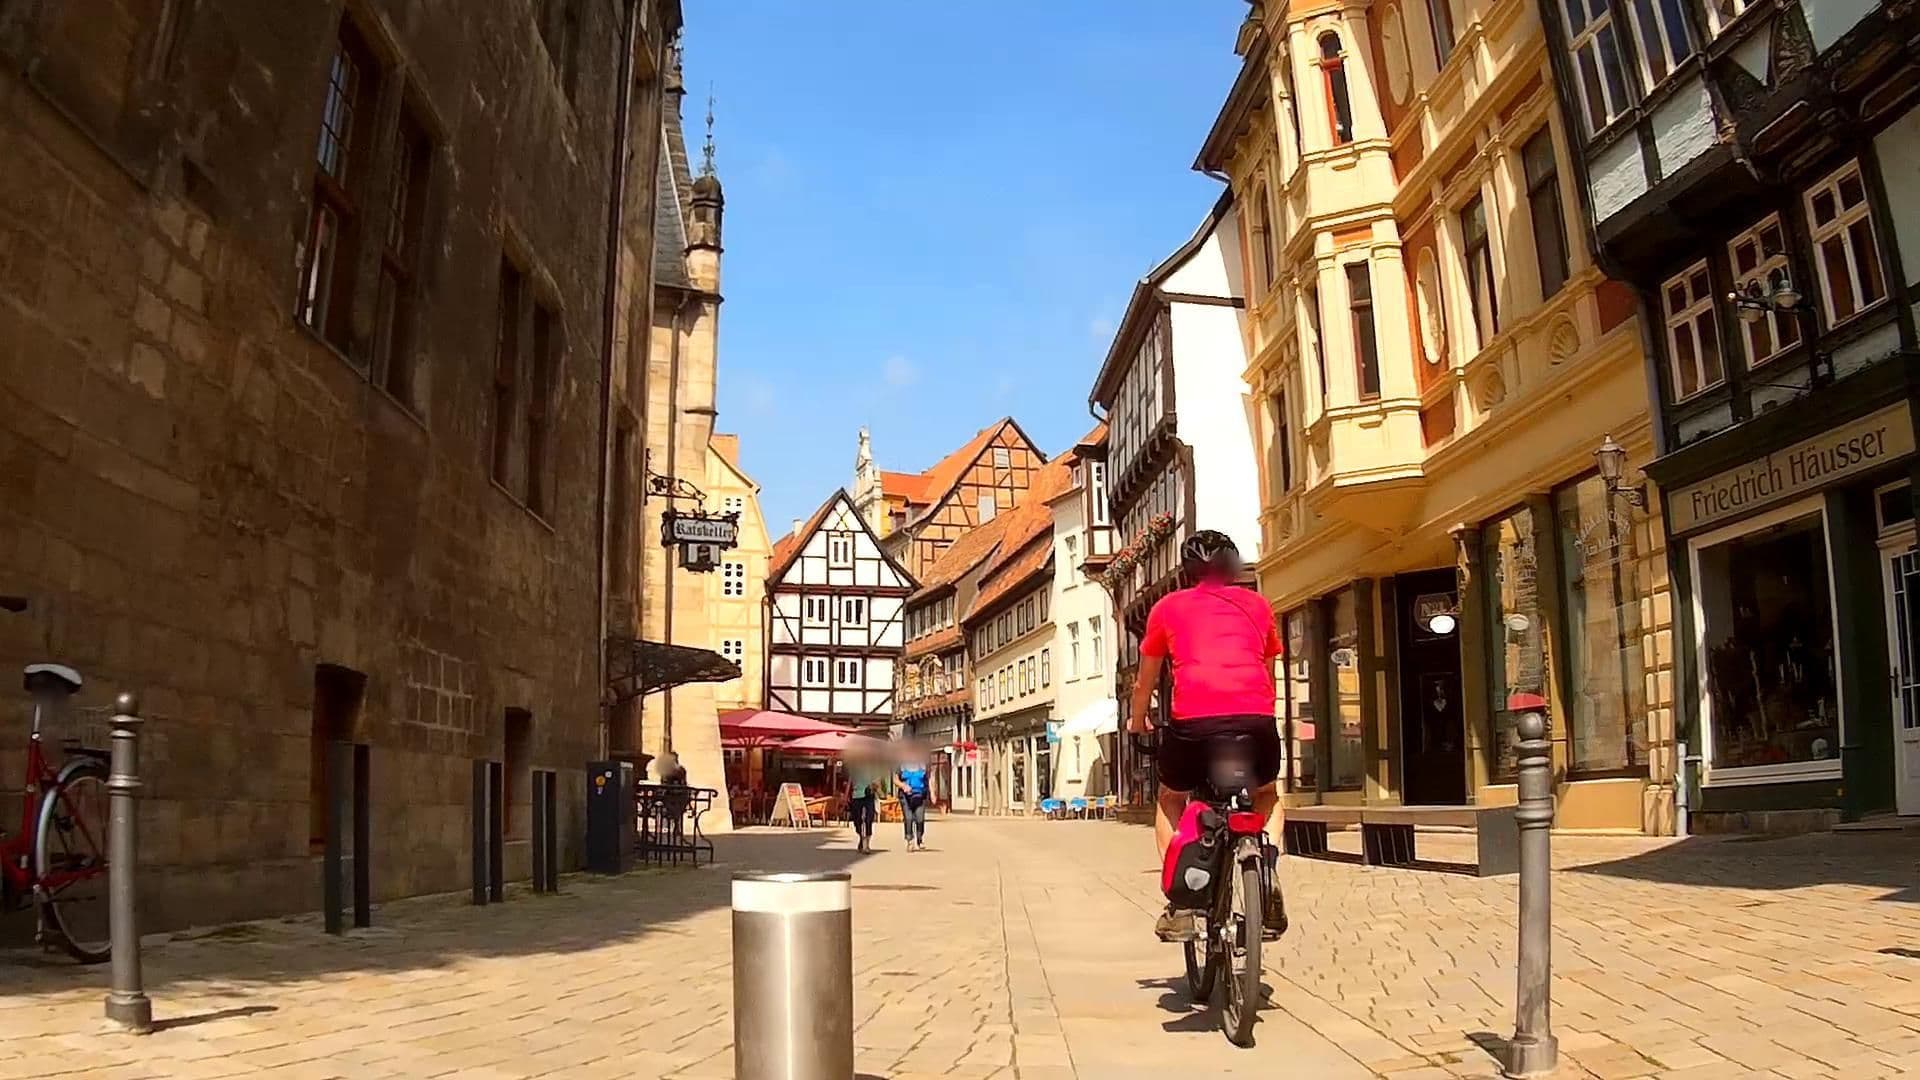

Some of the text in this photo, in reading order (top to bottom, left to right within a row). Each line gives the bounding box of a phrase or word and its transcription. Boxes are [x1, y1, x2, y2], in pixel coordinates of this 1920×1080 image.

[1691, 426, 1887, 520] Friedrich Häusser
[676, 522, 733, 538] Ratskeller
